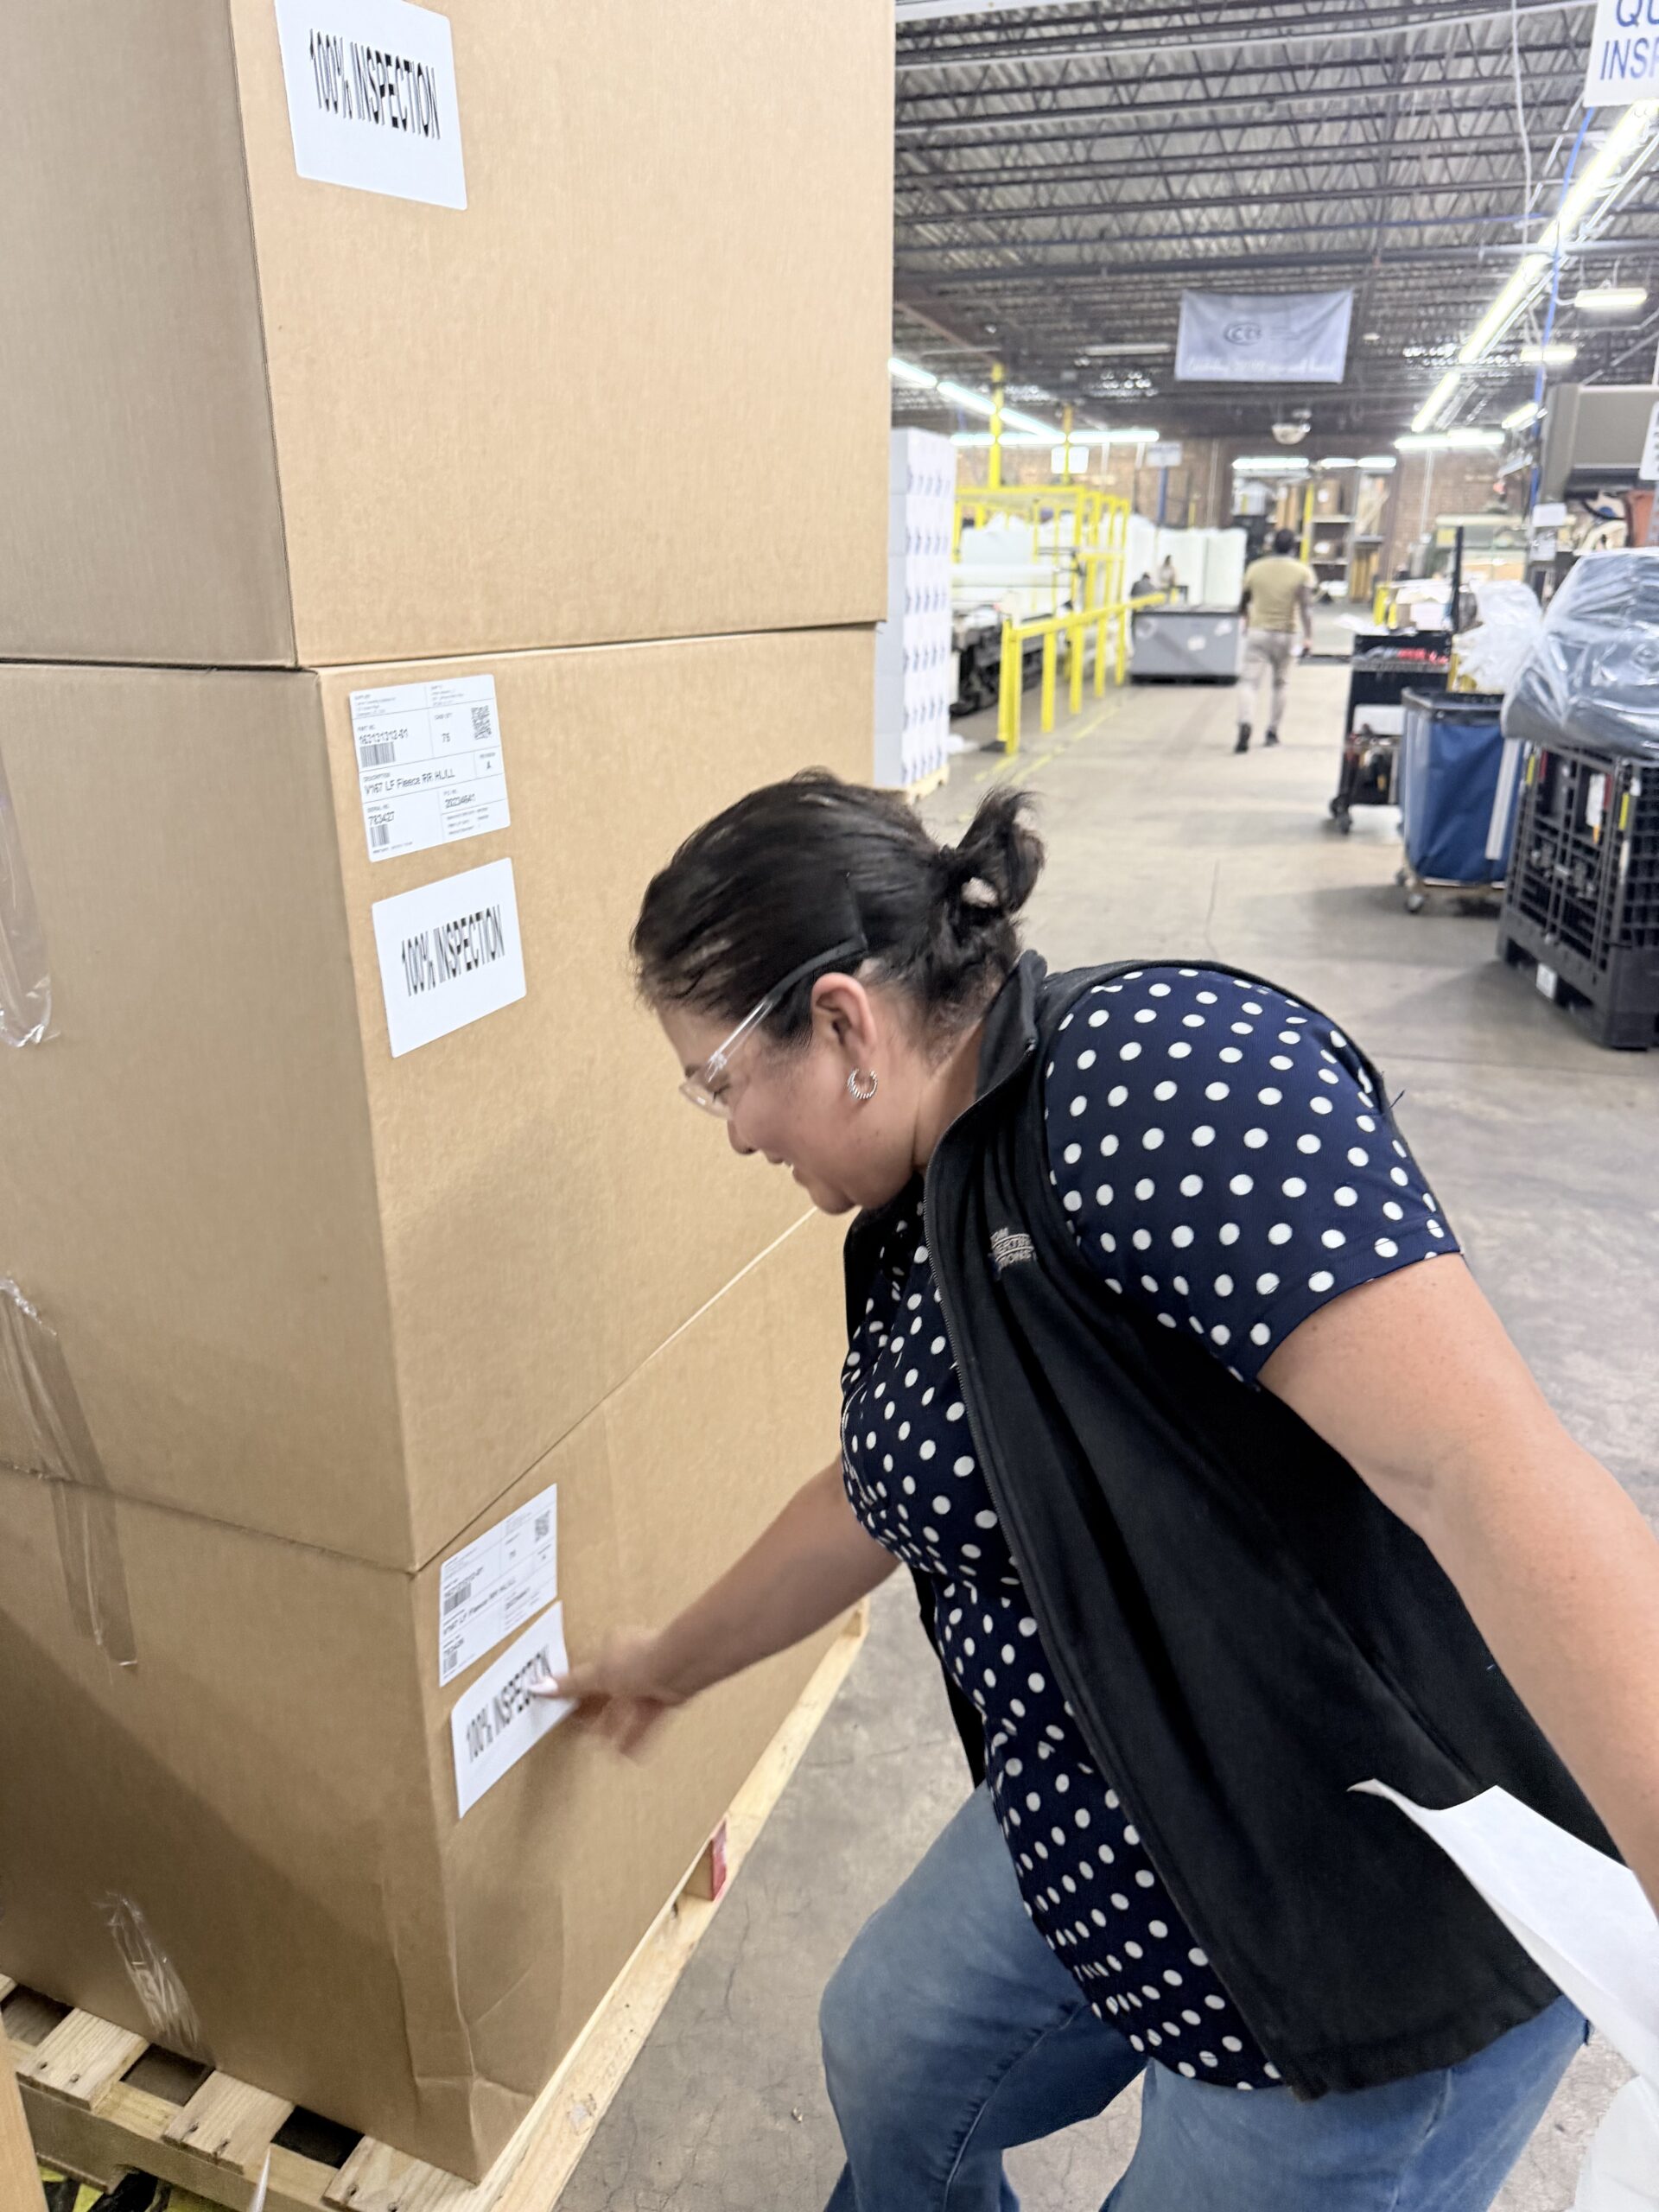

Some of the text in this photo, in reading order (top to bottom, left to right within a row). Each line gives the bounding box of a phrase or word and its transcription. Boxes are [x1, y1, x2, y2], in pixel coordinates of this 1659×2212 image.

[309, 29, 440, 140] 100% INSPECTION
[401, 905, 505, 997] 100% INSPECTION
[466, 1704, 493, 1763] 100%
